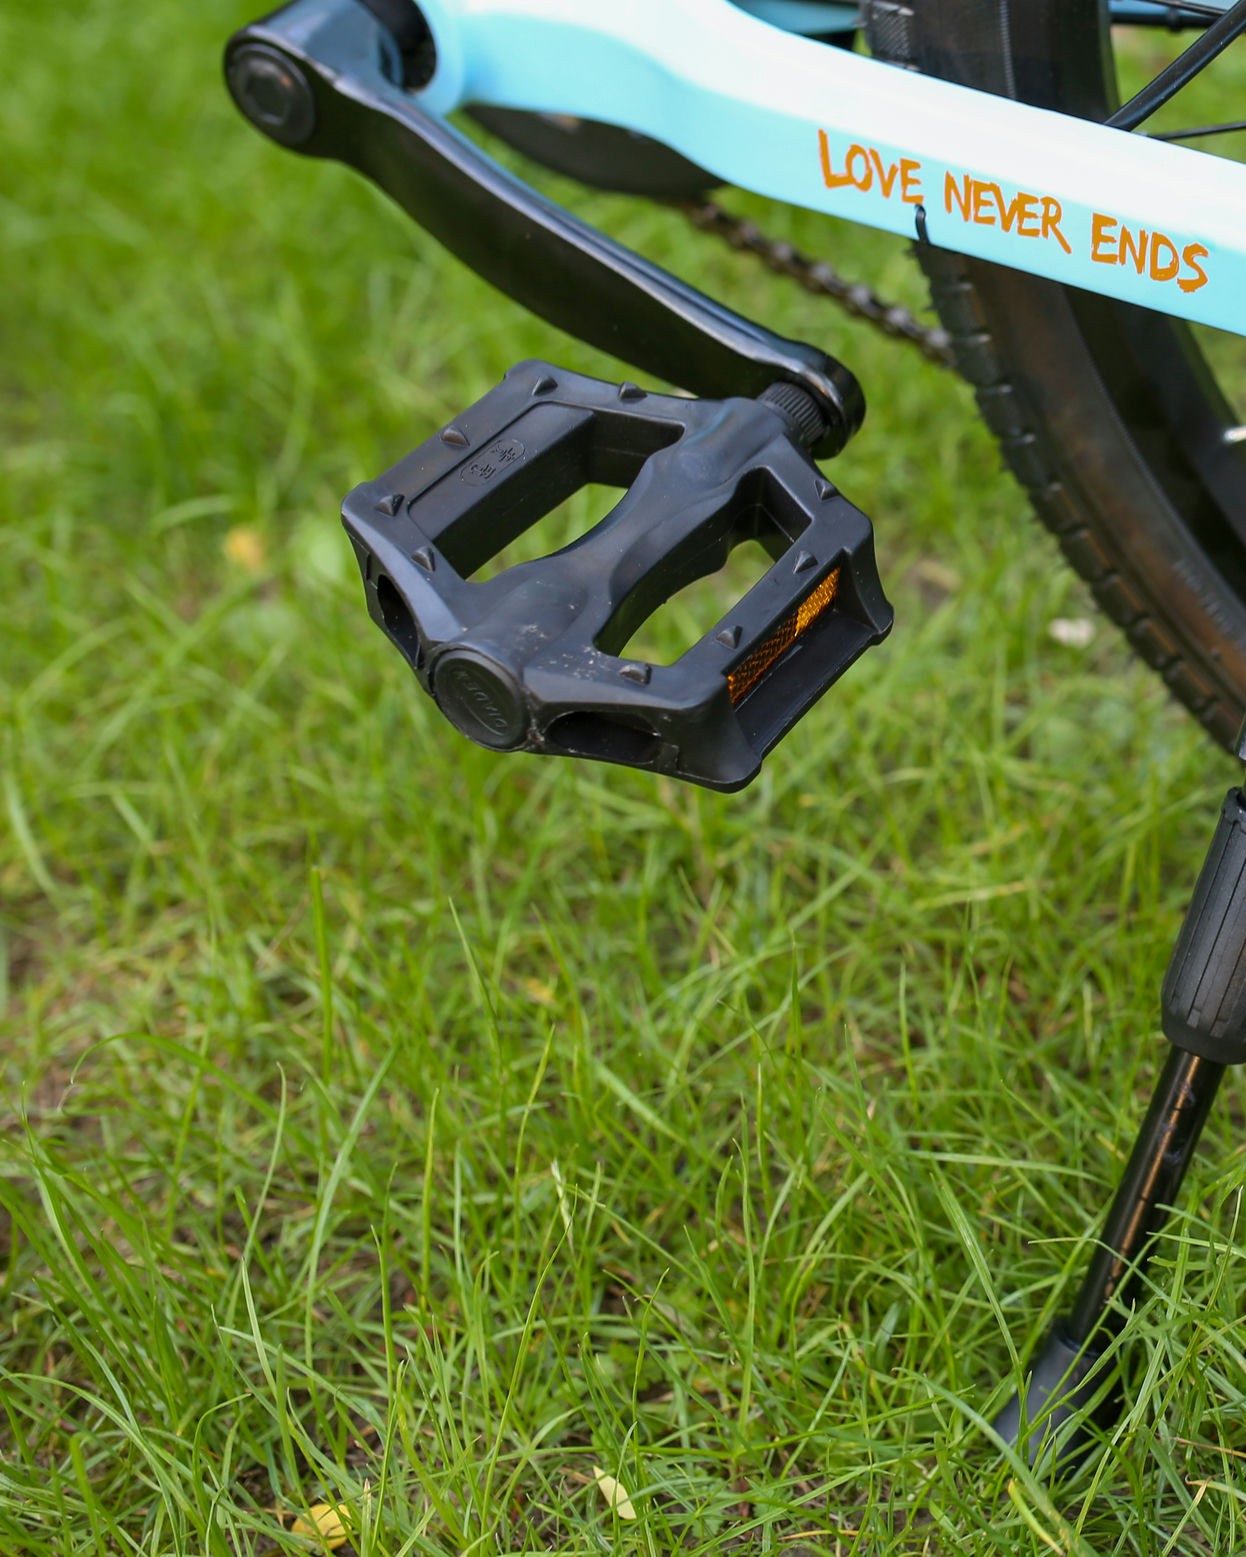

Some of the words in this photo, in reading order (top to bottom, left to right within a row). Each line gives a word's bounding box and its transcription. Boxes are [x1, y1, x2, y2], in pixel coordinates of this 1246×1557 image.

[818, 129, 924, 205] LOVE
[944, 170, 1072, 254] NEVER
[1091, 212, 1209, 293] ENDS
